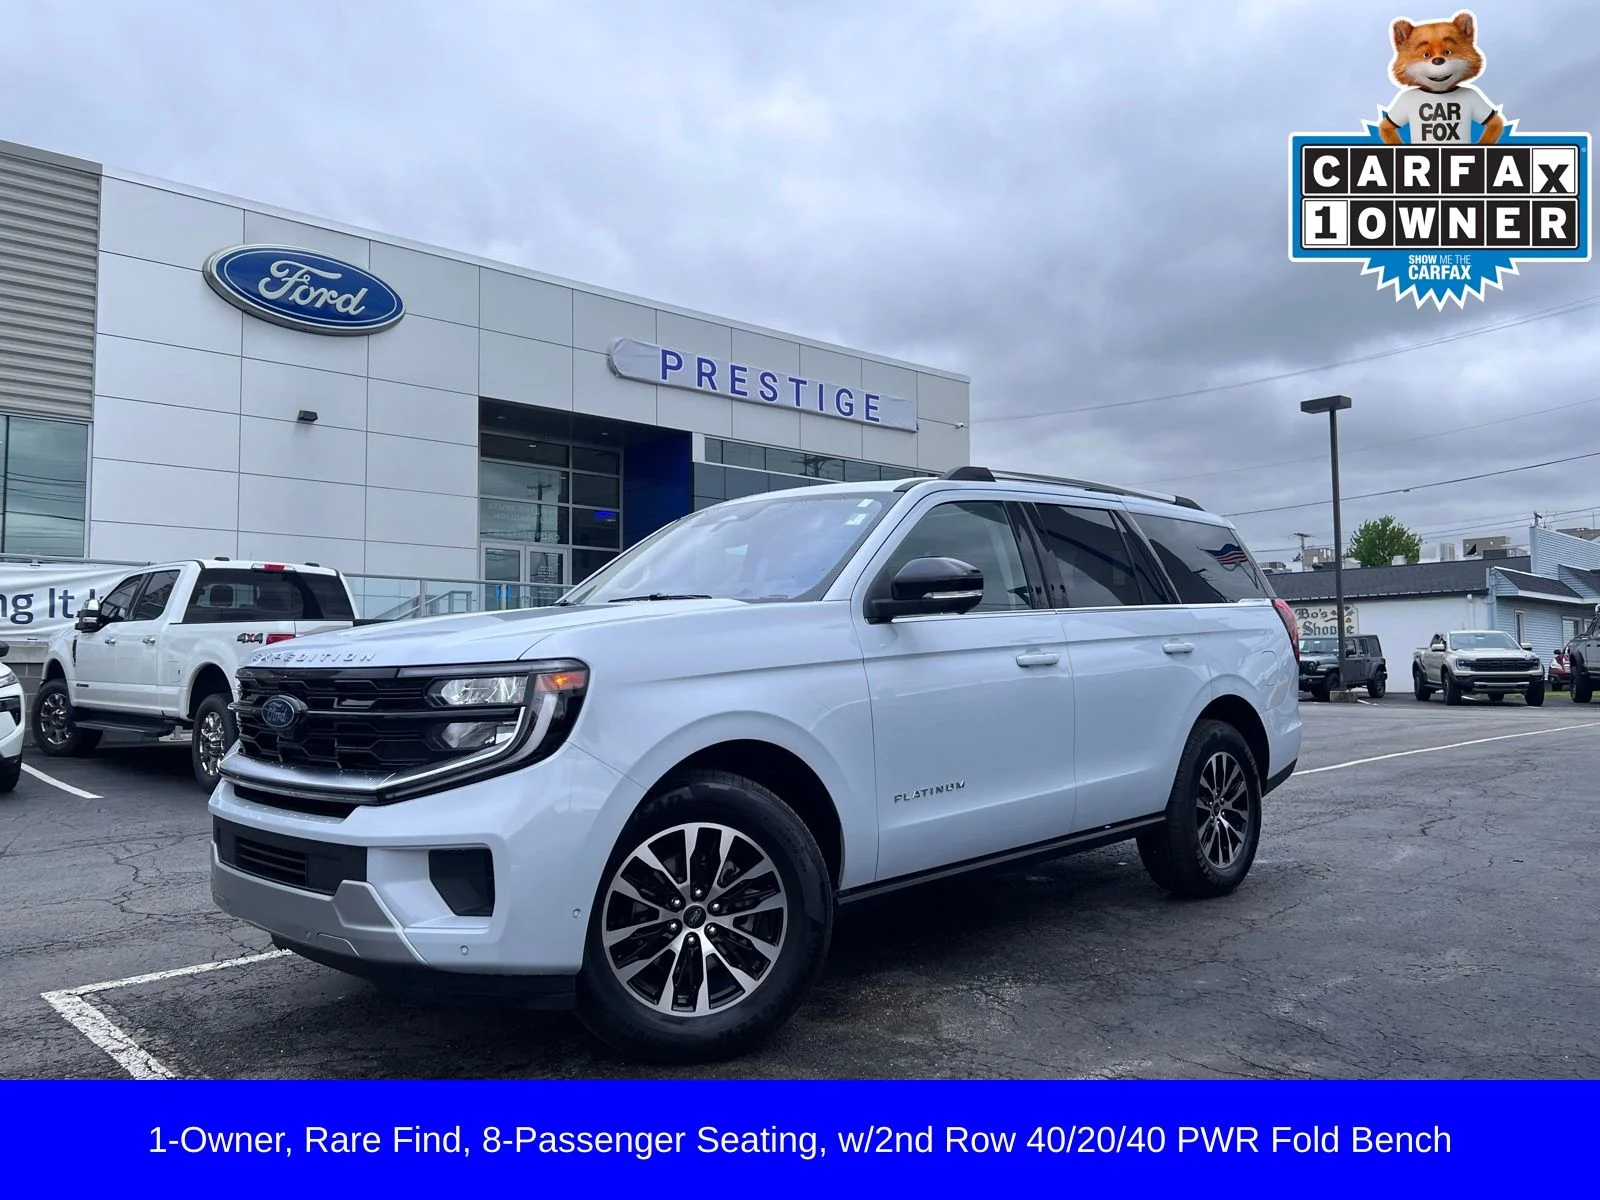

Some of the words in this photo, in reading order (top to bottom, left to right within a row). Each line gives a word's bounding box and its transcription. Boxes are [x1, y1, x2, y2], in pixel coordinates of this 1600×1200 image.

[258, 260, 369, 316] Ford
[660, 348, 881, 423] PRESTIGE
[48, 587, 75, 619] It
[1295, 608, 1329, 620] Bo's
[1302, 620, 1355, 637] Shope
[252, 652, 377, 663] EXPEDITION
[893, 780, 966, 803] PLATINUM
